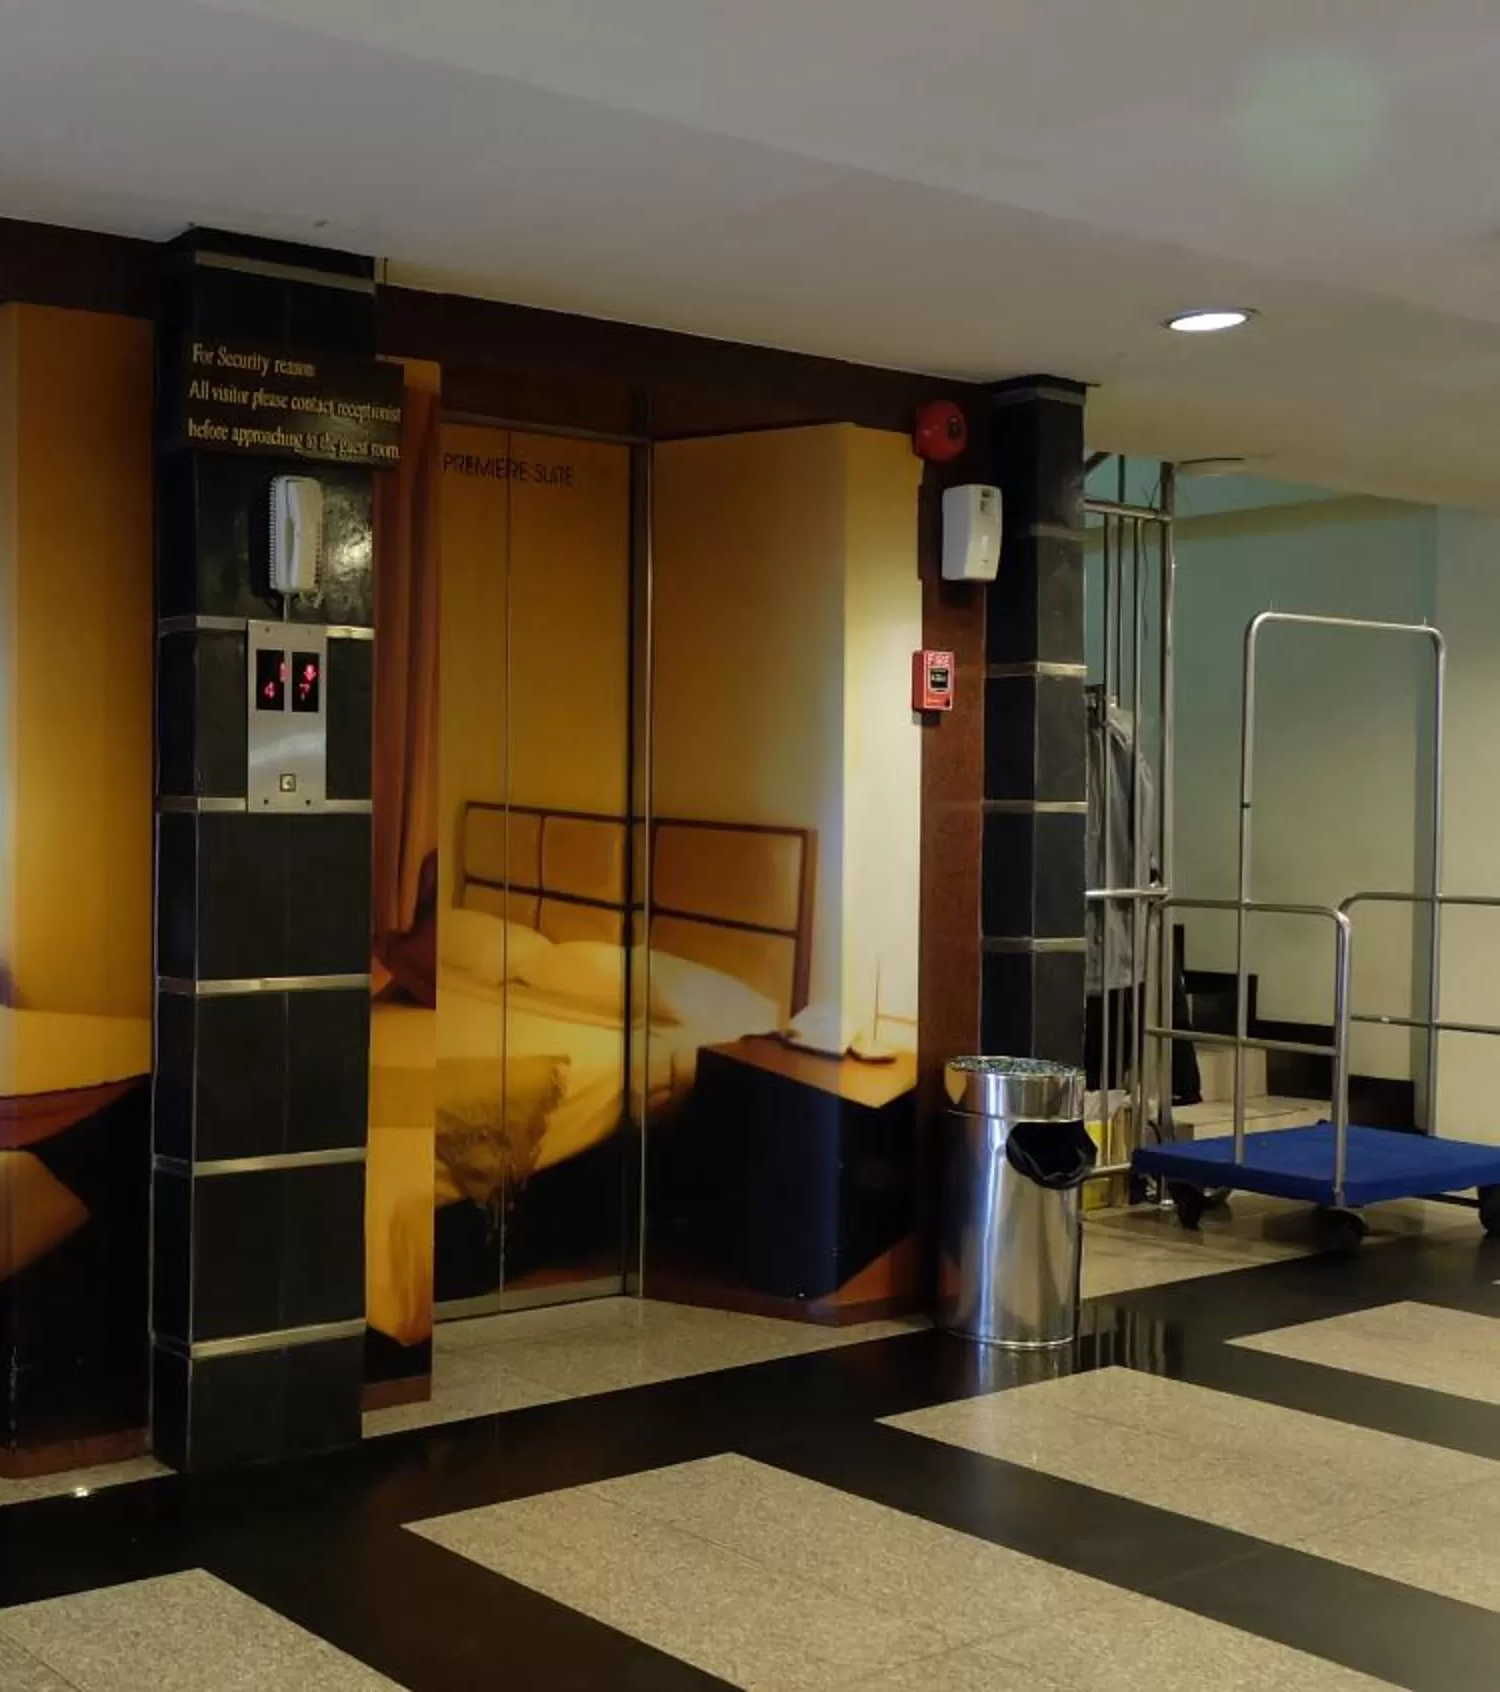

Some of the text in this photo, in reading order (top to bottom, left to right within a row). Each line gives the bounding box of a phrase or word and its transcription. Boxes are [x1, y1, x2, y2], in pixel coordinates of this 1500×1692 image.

[192, 342, 317, 378] For Security reason
[189, 379, 402, 424] All visitor please contact receptionist
[187, 417, 229, 440] before
[231, 424, 305, 454] approaching
[306, 433, 318, 450] to
[319, 431, 338, 450] the
[443, 452, 575, 488] PREMIERE SUITE
[927, 652, 950, 668] FIRE
[264, 681, 275, 699] 4
[299, 682, 311, 700] 7
